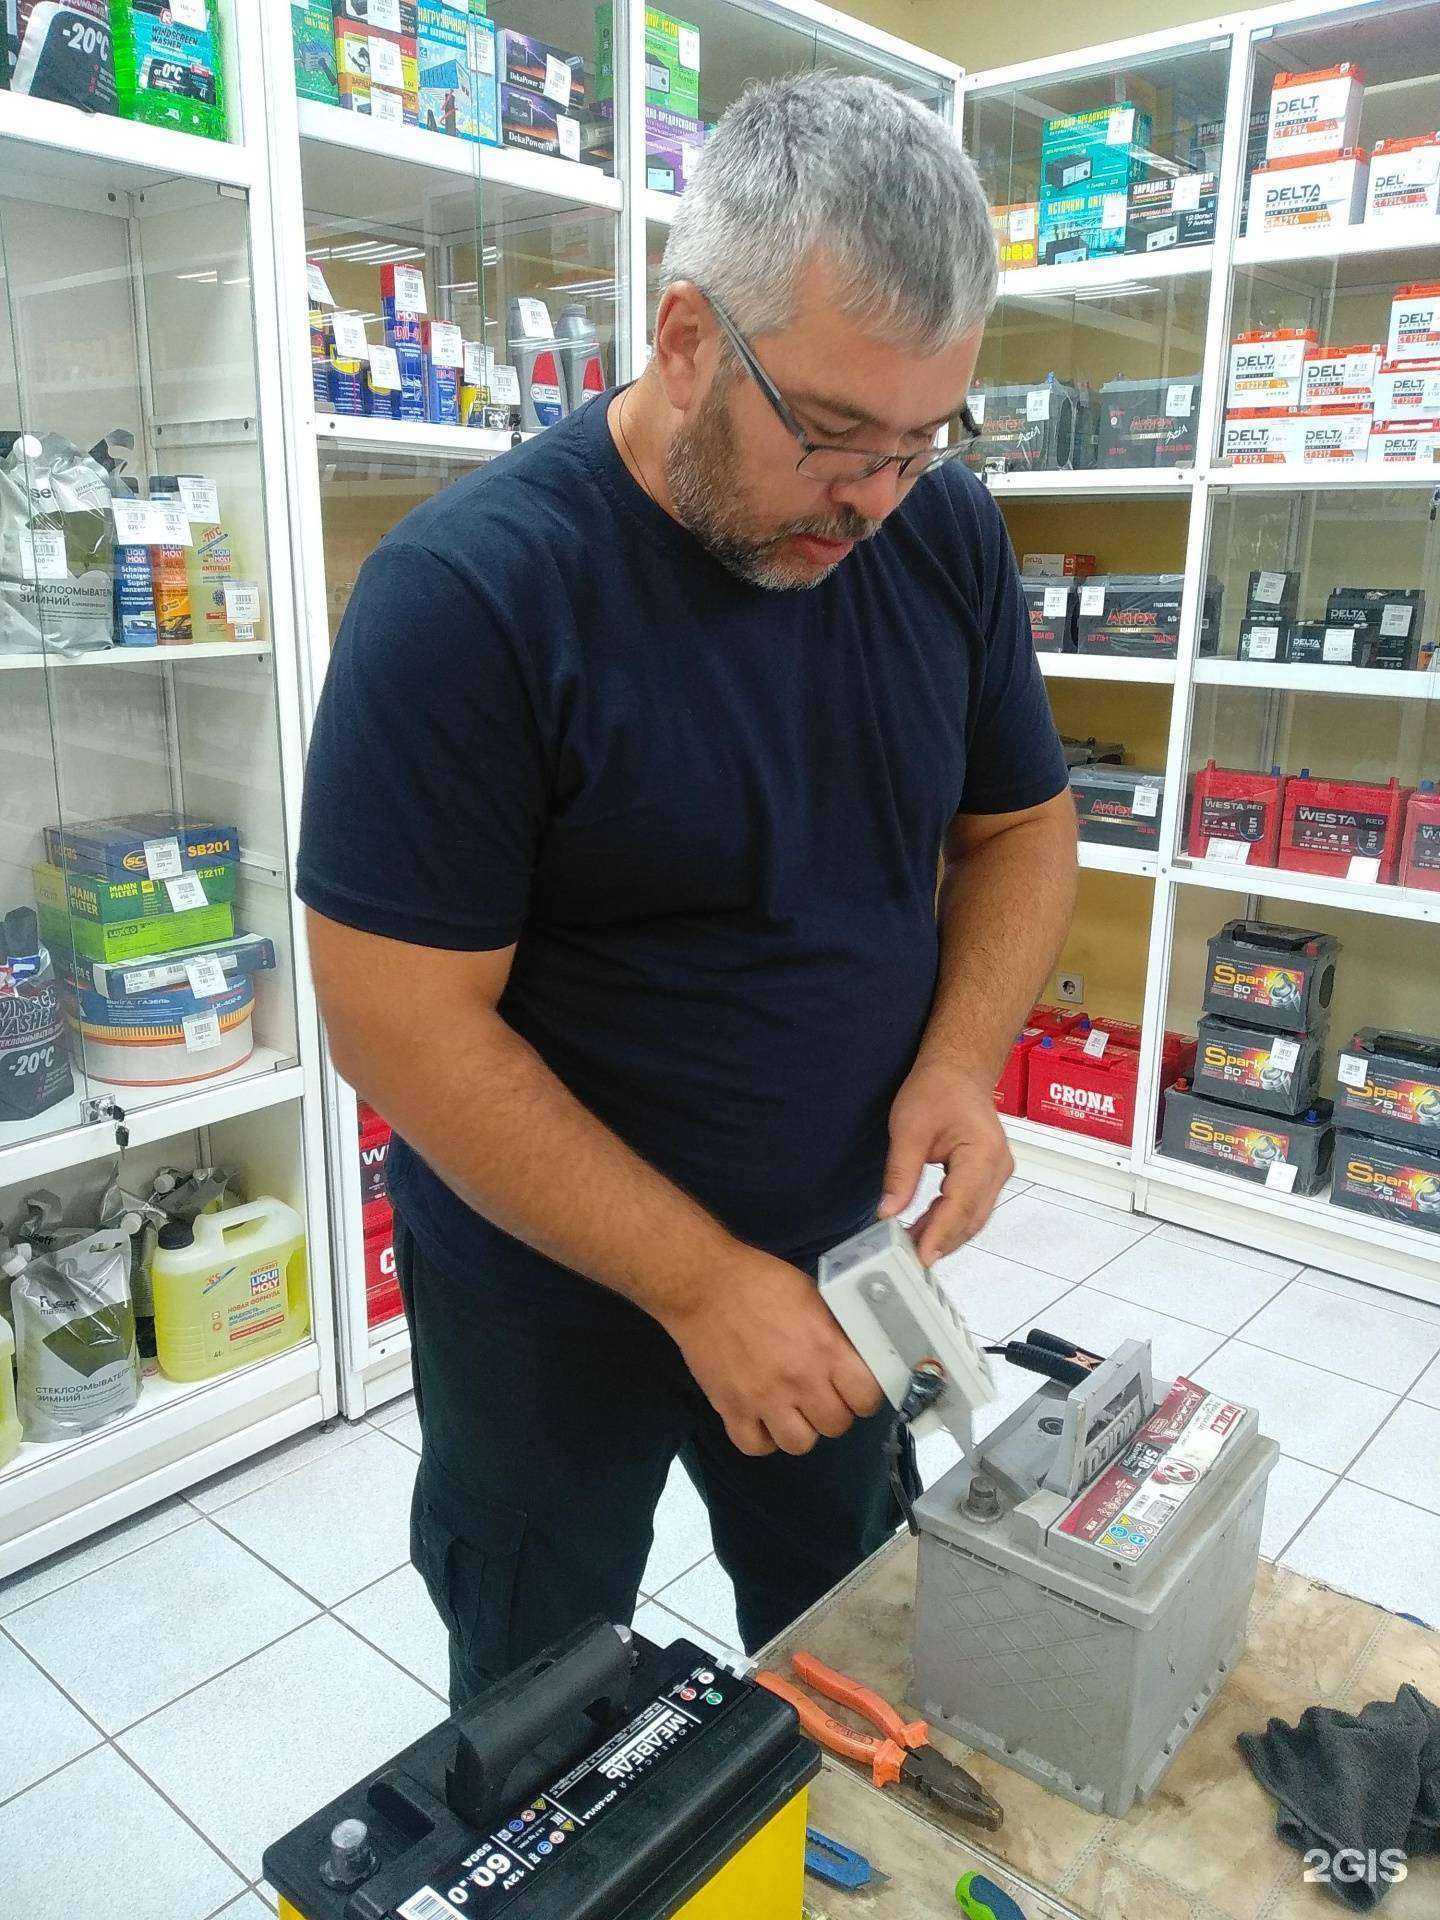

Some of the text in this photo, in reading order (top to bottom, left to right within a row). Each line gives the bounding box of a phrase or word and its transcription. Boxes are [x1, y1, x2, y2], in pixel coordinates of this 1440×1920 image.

[152, 25, 199, 46] WINDSCREEN
[1276, 95, 1319, 114] DELT
[508, 131, 545, 149] DekaPower
[1266, 184, 1321, 203] DELTA
[1399, 312, 1434, 324] DELT
[1393, 379, 1425, 389] DELT
[1228, 429, 1269, 441] DELT
[126, 548, 146, 556] LIQUI
[127, 556, 146, 564] MOLY
[1331, 609, 1368, 621] DELTA
[1292, 638, 1322, 648] DELTA
[1205, 799, 1244, 811] WESTA
[1299, 810, 1357, 826] WESTA
[186, 840, 230, 858] SB201
[69, 884, 97, 902] MANN
[109, 881, 138, 893] MANN
[110, 888, 138, 900] FILTER
[71, 895, 98, 916] FILTER
[1213, 963, 1270, 987] Spark
[1233, 984, 1251, 994] 60
[9, 1047, 55, 1078] -20°C
[1204, 1046, 1262, 1070] Spark
[1049, 1082, 1116, 1114] CRONA
[1373, 1098, 1394, 1110] 75
[1070, 1110, 1085, 1119] 100
[1189, 1121, 1253, 1149] Spark
[1346, 1161, 1415, 1190] Spark
[1373, 1183, 1393, 1196] 75
[251, 1269, 279, 1286] LIQUI
[252, 1279, 280, 1295] MOLY
[605, 1713, 688, 1779] МЕДВЕДЬ
[503, 1869, 525, 1890] 12V
